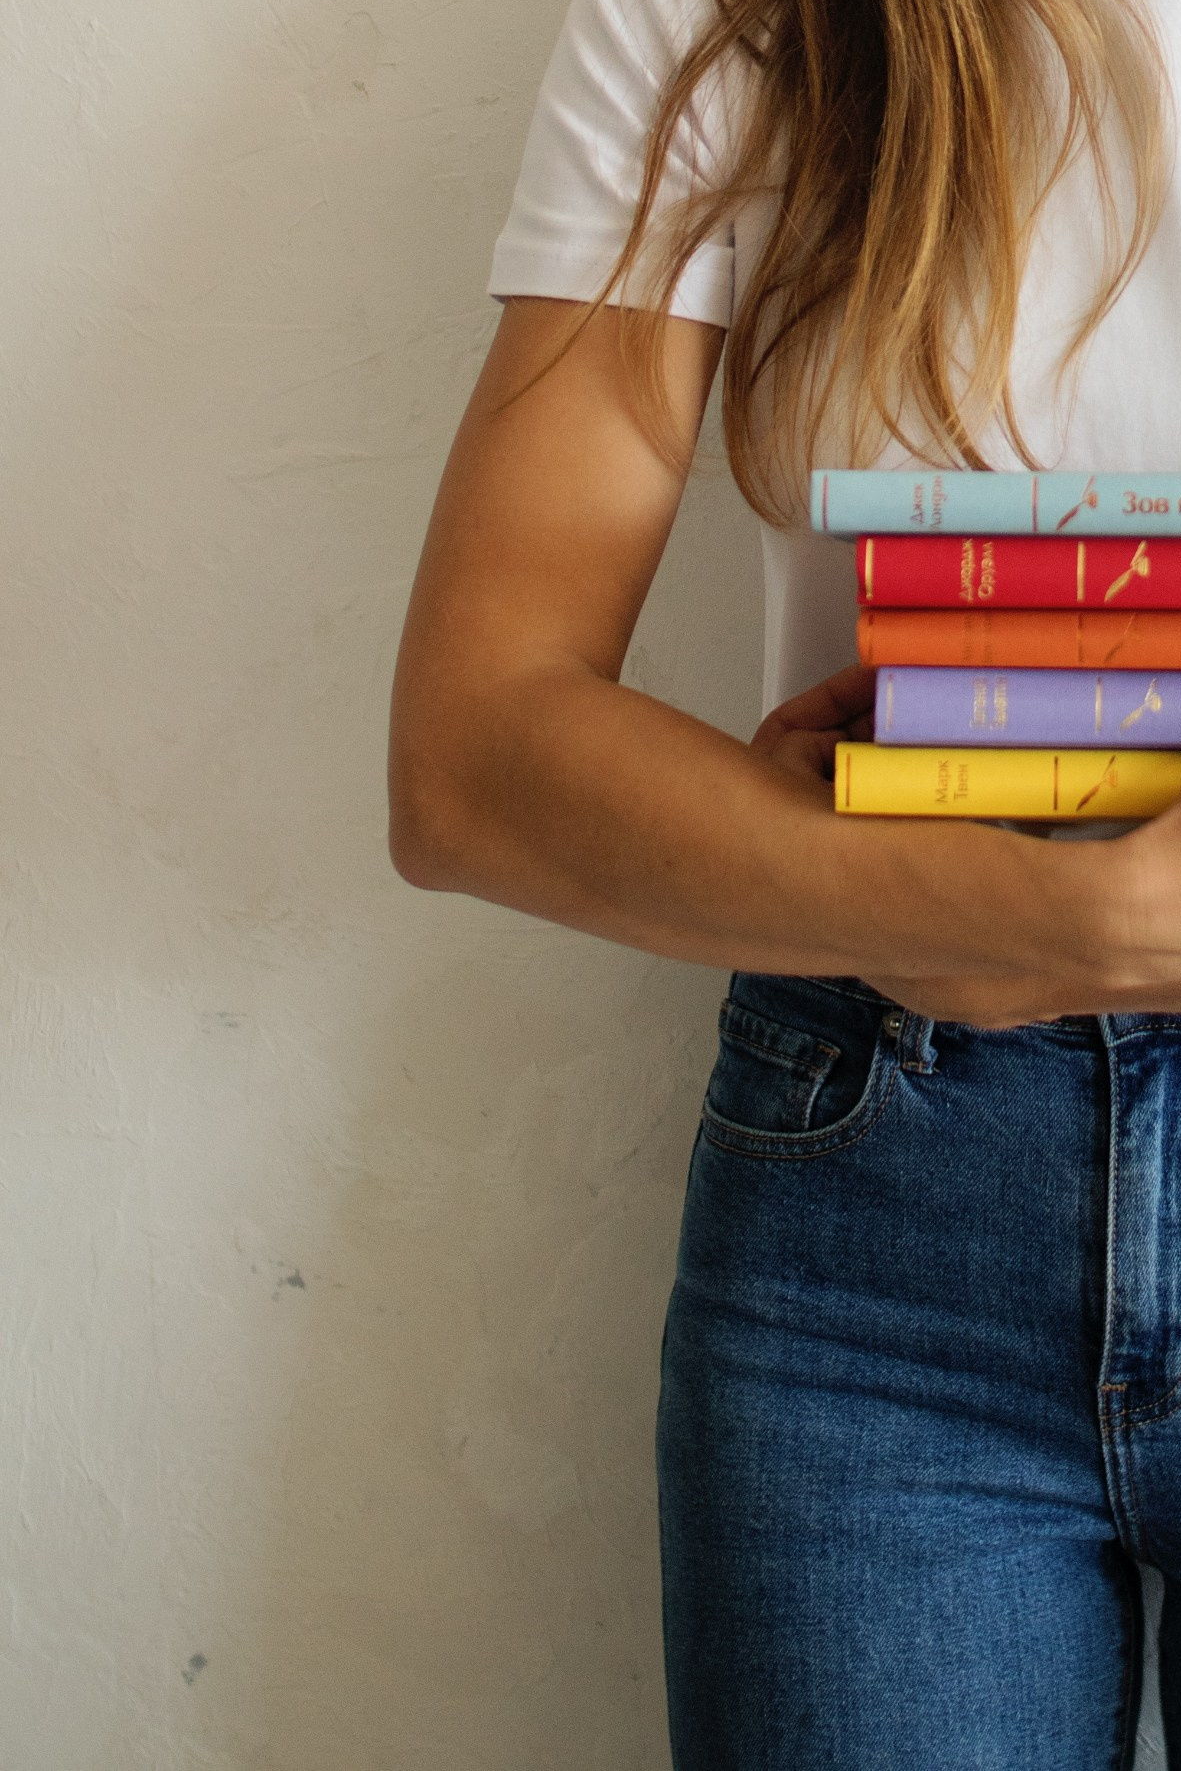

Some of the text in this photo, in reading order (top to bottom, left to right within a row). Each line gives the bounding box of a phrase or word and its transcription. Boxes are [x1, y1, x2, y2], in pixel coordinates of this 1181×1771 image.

[1122, 491, 1169, 515] Зов
[978, 542, 995, 599] Оруэлл
[936, 759, 950, 804] Марк
[954, 764, 968, 801] Твен
